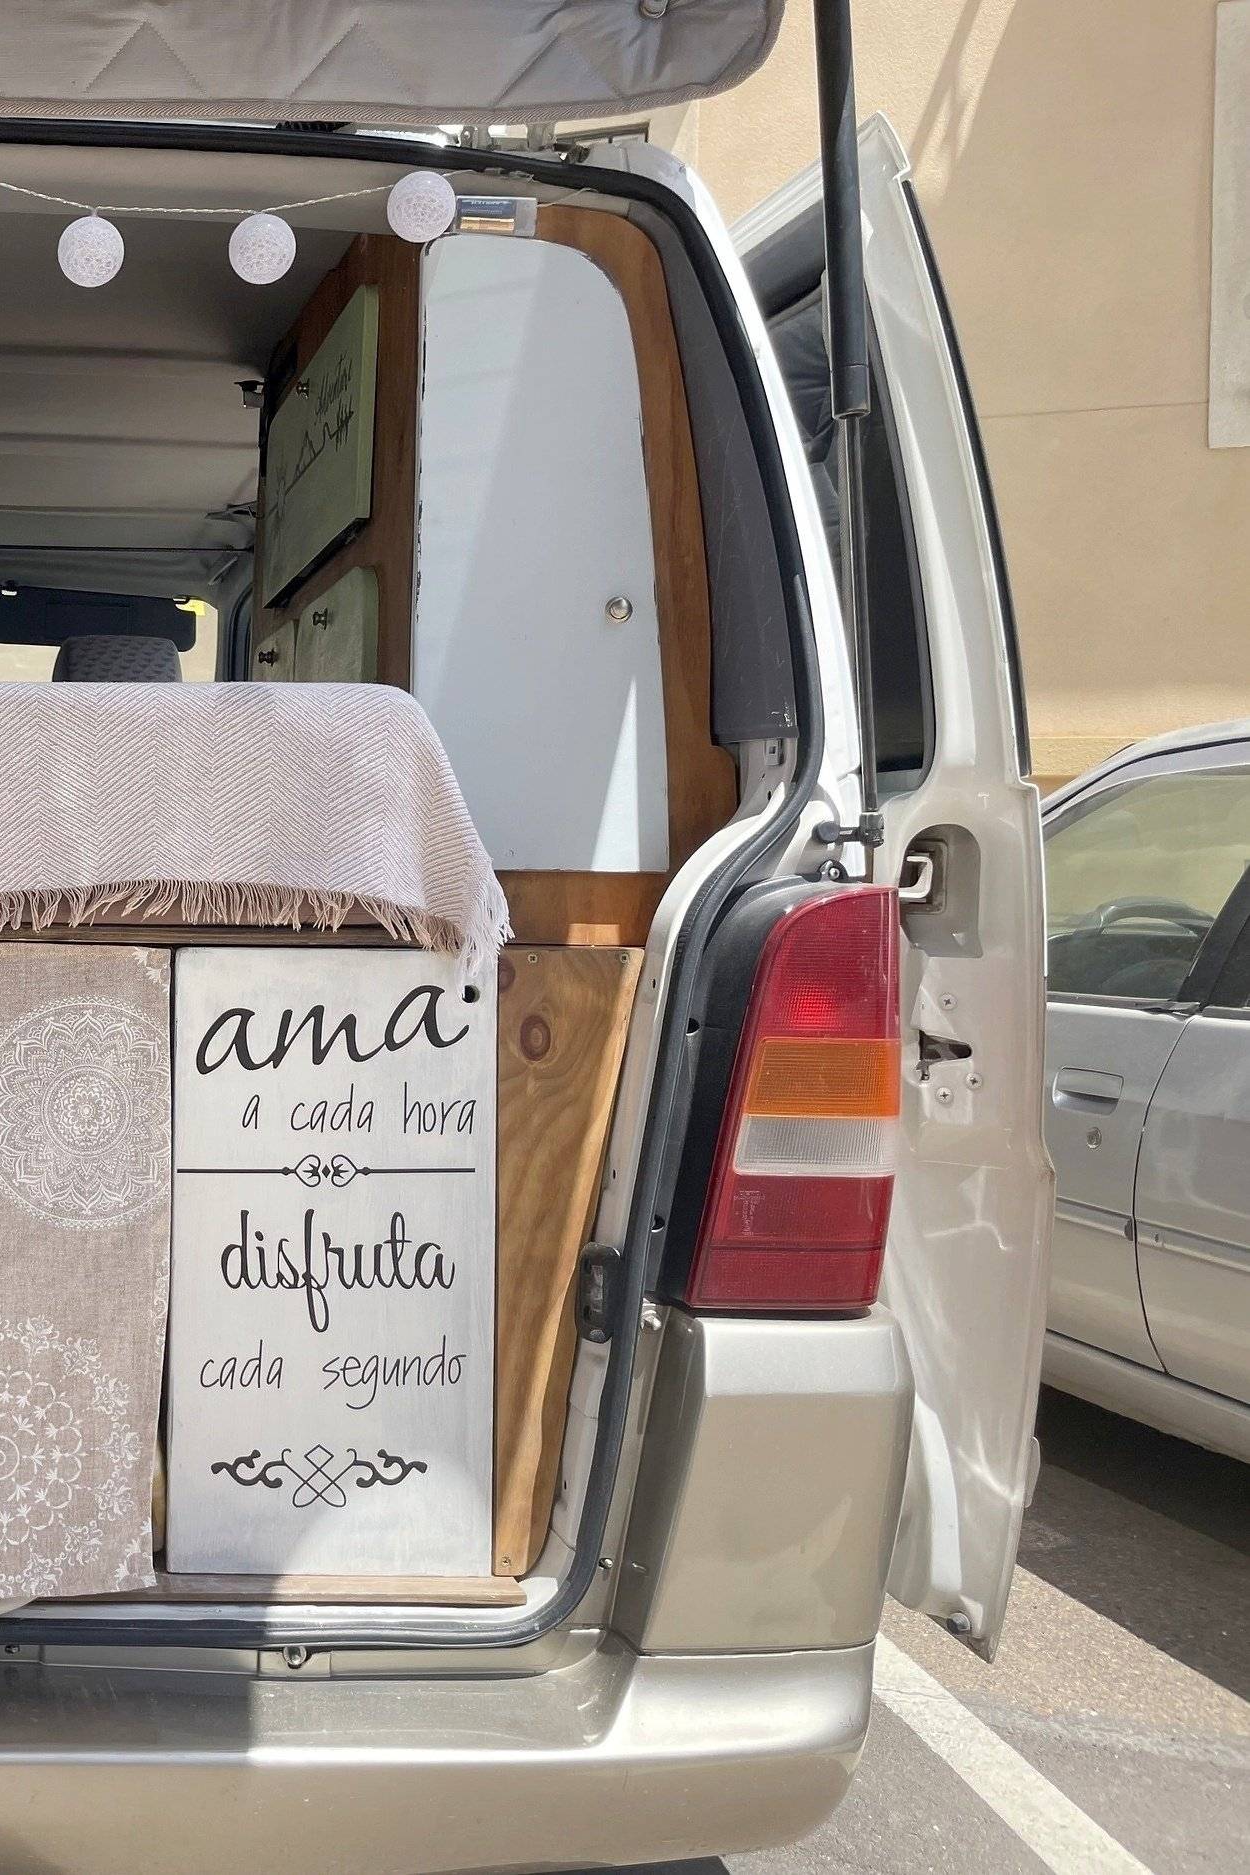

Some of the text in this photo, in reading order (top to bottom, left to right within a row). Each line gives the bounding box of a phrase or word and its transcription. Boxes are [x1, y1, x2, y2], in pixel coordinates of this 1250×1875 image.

[195, 984, 470, 1076] ama
[241, 1081, 477, 1136] a cada hora
[220, 1208, 456, 1334] disfruta
[199, 1334, 467, 1410] cada segundo
